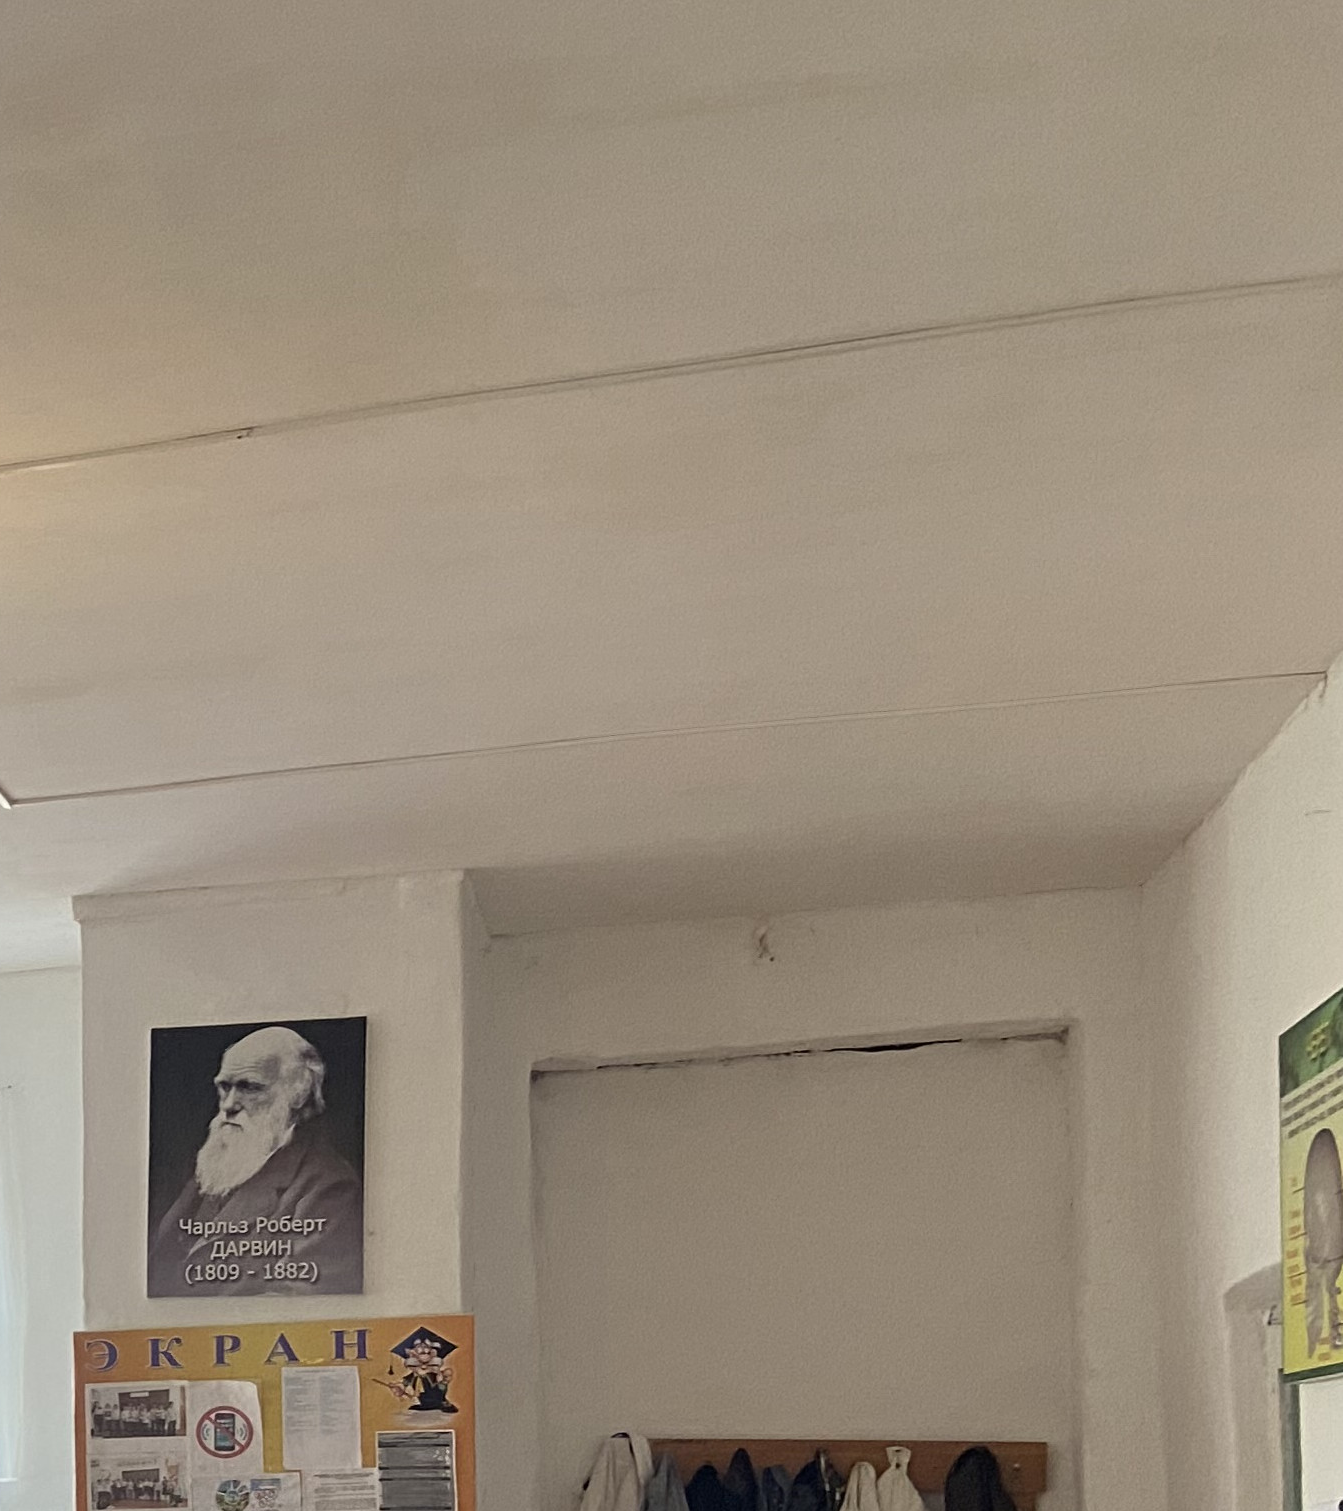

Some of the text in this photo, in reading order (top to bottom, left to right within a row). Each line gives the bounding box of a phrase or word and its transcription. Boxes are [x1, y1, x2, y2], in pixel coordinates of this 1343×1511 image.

[179, 1216, 326, 1235] Чарльз Роберт
[210, 1240, 292, 1259] ДАРВИН
[184, 1263, 240, 1284] (1809
[263, 1262, 318, 1283] 1882)
